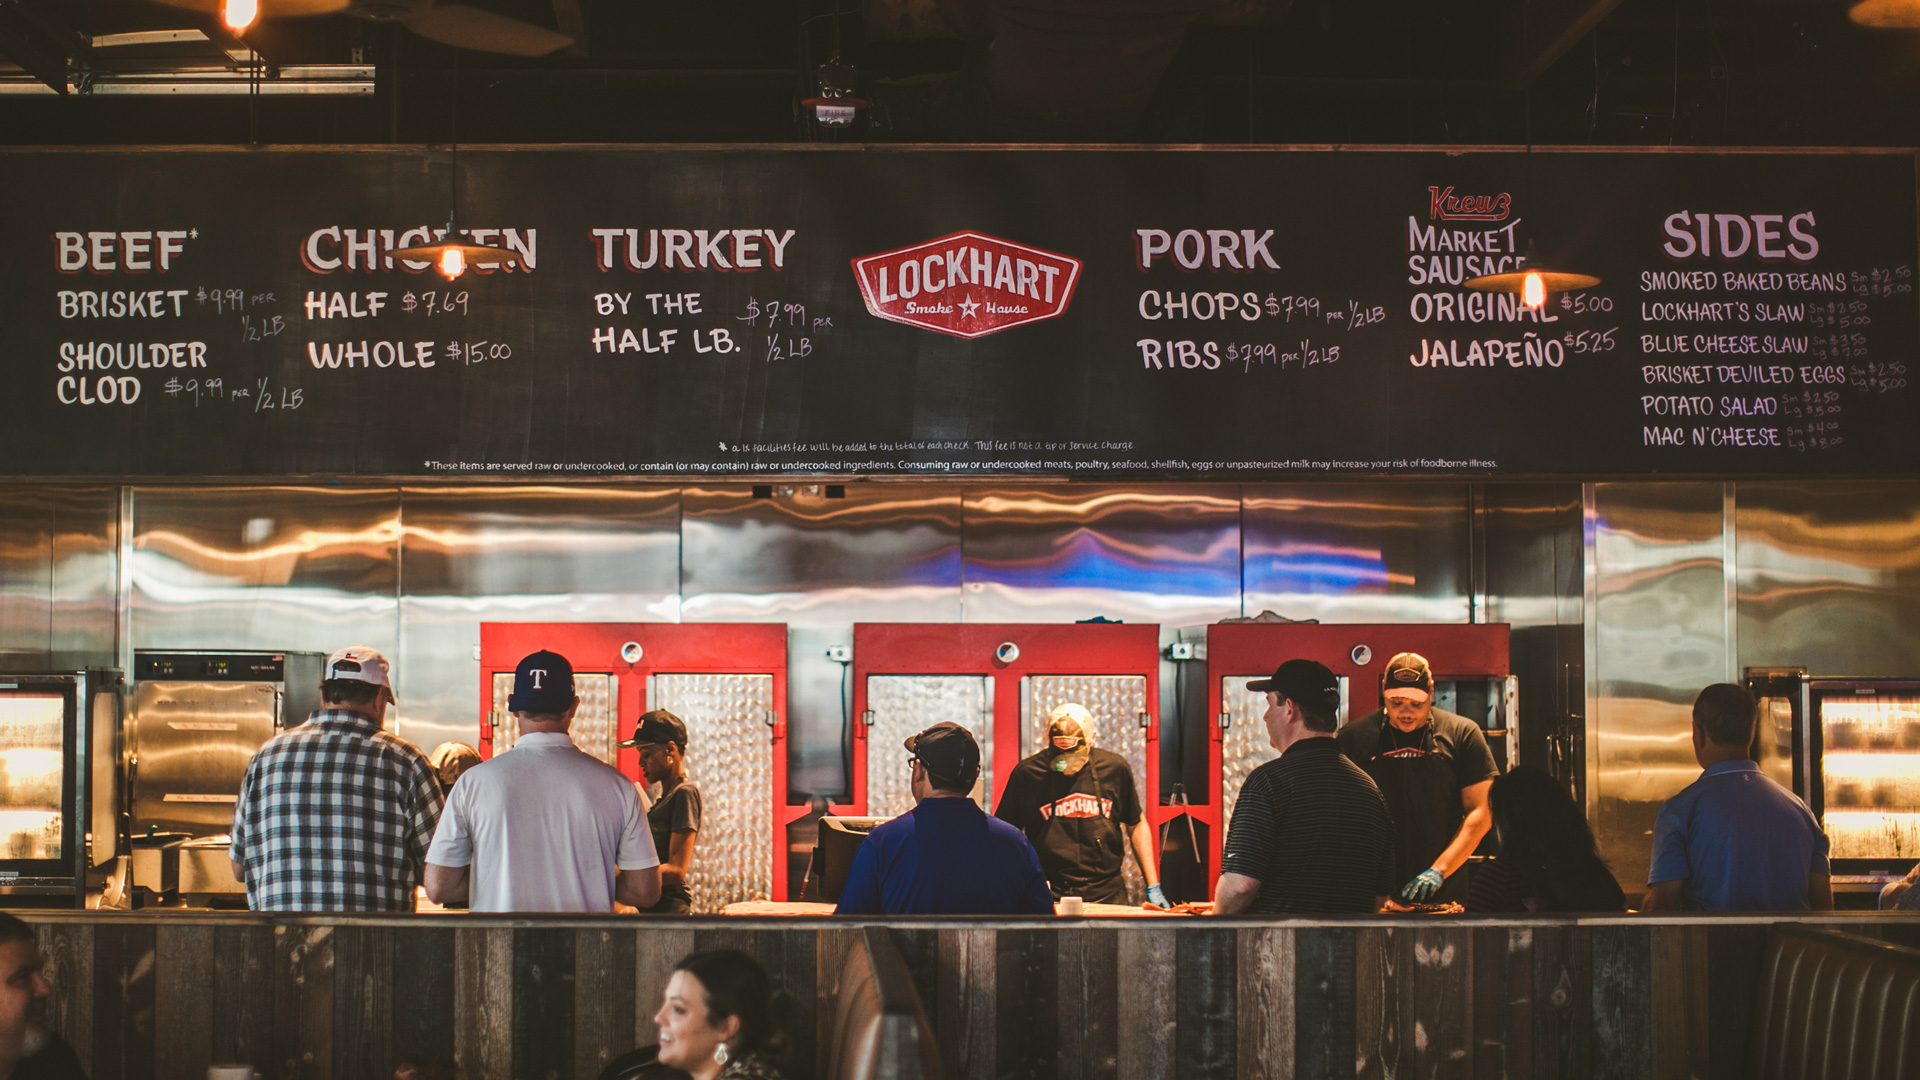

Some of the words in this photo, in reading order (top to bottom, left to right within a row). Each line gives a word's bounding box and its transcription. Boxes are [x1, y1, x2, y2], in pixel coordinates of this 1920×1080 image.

[1660, 209, 1820, 263] SIDES
[589, 228, 796, 272] TURKEY
[1133, 229, 1281, 273] PORK
[879, 246, 1060, 304] LOCKHART
[1640, 271, 1717, 292] SMOKED
[1722, 271, 1783, 291] BAKED
[1786, 272, 1847, 291] BEANS
[1851, 271, 1868, 282] Sm
[57, 290, 189, 318] BRISKET
[194, 286, 244, 315] $9.99
[305, 290, 388, 320] HALF
[401, 290, 469, 317] $7.69
[594, 292, 632, 315] BY
[645, 293, 702, 315] THE
[736, 296, 805, 328] $7.99
[905, 301, 954, 315] Smoke
[986, 302, 1029, 314] House
[1138, 290, 1261, 321] CHOPS
[1265, 293, 1320, 323] $7.99
[1366, 306, 1386, 323] LB
[1410, 291, 1559, 323] ORIGINAL
[1561, 292, 1613, 314] $5.00
[1641, 301, 1750, 322] LOCKHART'S
[1755, 302, 1805, 323] SLAW
[263, 315, 286, 336] LB
[444, 340, 512, 366] $15.00
[592, 327, 678, 354] HALF
[693, 328, 741, 354] LB.
[789, 338, 812, 358] LB
[1409, 332, 1564, 368] JALAPEÑO
[1564, 327, 1619, 354] $5.25
[1640, 334, 1690, 353] BLUE
[1693, 334, 1758, 354] CHEESE
[1761, 335, 1808, 354] SLAW
[57, 341, 208, 373] SHOULDER
[308, 340, 436, 369] WHOLE
[1137, 339, 1221, 370] RIBS
[1226, 342, 1277, 373] $7.99
[1322, 346, 1340, 364] LB
[1641, 365, 1713, 384] BRISKET
[1716, 365, 1794, 383] DEVILED
[1800, 365, 1846, 384] EGGS
[57, 376, 141, 405] CLOD
[164, 377, 224, 408] $9.99
[282, 388, 304, 409] LB
[1641, 395, 1714, 416] POTATO
[1720, 396, 1777, 417] SALAD
[732, 444, 741, 452] a
[753, 443, 791, 452] facilities
[793, 443, 807, 452] fee
[810, 442, 829, 451] will
[832, 442, 843, 451] be
[845, 442, 867, 451] added
[869, 442, 877, 451] to
[880, 442, 893, 451] the
[895, 442, 916, 451] total
[918, 442, 925, 451] of
[927, 442, 942, 451] each
[974, 441, 992, 450] This
[995, 441, 1007, 450] fee
[1019, 441, 1032, 450] not
[1035, 442, 1042, 450] a
[1045, 441, 1057, 451] tip
[1058, 442, 1066, 450] or
[1069, 441, 1099, 450] service
[1643, 426, 1685, 446] MAC
[460, 461, 485, 469] items
[503, 461, 532, 469] served
[565, 461, 626, 471] undercooked,
[640, 461, 673, 469] contain
[676, 461, 688, 471] (or
[691, 463, 709, 471] may
[712, 461, 749, 471] contain)
[782, 461, 841, 469] undercooked
[844, 461, 896, 471] ingredients.
[898, 460, 949, 470] Consuming
[982, 460, 1041, 468] undercooked
[1044, 460, 1073, 470] meats,
[1076, 460, 1109, 470] poultry,
[1112, 460, 1149, 470] seafood,
[1152, 460, 1189, 470] shellfish,
[1192, 462, 1213, 470] eggs
[1227, 460, 1289, 470] unpasteurized
[1292, 460, 1310, 468] milk
[1312, 461, 1330, 470] may
[1333, 460, 1369, 468] increase
[1371, 461, 1390, 469] your
[1393, 459, 1408, 467] risk
[1410, 459, 1418, 467] of
[1421, 459, 1467, 467] foodborne
[1470, 459, 1498, 467] illness.
[529, 669, 547, 689] T
